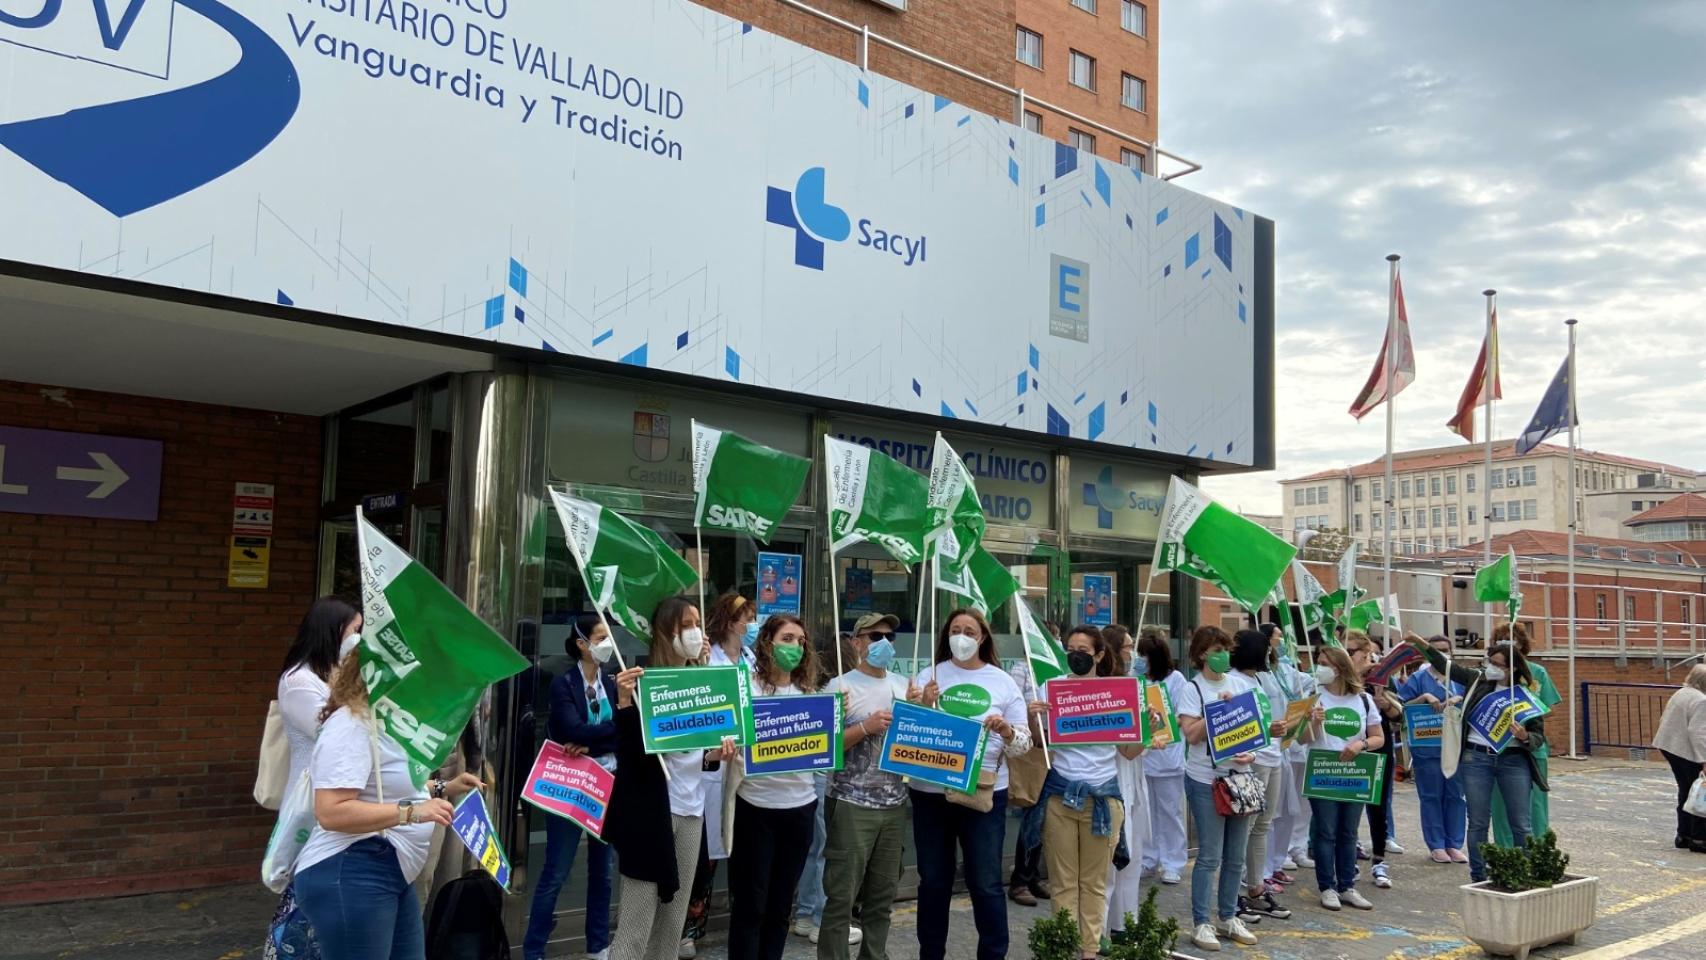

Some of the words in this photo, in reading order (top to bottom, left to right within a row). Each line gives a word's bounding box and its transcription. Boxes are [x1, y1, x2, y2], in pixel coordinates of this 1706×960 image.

[465, 22, 504, 64] DE
[512, 38, 684, 120] VALLADOLID
[287, 12, 505, 109] Vanguardia
[519, 95, 538, 124] y
[551, 95, 683, 161] Tradición
[858, 219, 926, 266] Sacyl
[1059, 263, 1081, 312] E
[628, 465, 687, 486] Castilla
[963, 448, 1048, 485] CLÍNICO
[707, 504, 774, 537] SATSE
[650, 685, 711, 703] Enfermeras
[738, 669, 749, 708] SATSE
[1057, 691, 1112, 705] Enfermeras
[652, 702, 677, 717] para
[679, 700, 693, 709] un
[695, 694, 726, 708] futuro
[1058, 704, 1081, 716] para
[1082, 702, 1095, 711] un
[1096, 699, 1127, 710] futuro
[1211, 706, 1244, 726] Enfermeras
[658, 713, 725, 733] saludable
[754, 711, 810, 729] Enfermeras
[898, 721, 953, 737] Enfermeras
[1061, 715, 1126, 731] equitativo
[1214, 722, 1229, 735] para
[1229, 718, 1238, 727] un
[1237, 710, 1253, 723] futuro
[755, 729, 778, 742] para
[779, 725, 792, 734] un
[794, 720, 823, 733] futuro
[896, 733, 919, 743] para
[920, 736, 933, 745] un
[935, 737, 964, 749] futuro
[1218, 725, 1256, 747] innovador
[1415, 727, 1442, 737] sosten
[757, 738, 821, 757] innovador
[894, 747, 958, 767] sostenible
[546, 760, 598, 784] Enfermeras
[1314, 777, 1362, 788] saludable
[542, 770, 565, 781] para
[567, 776, 580, 785] un
[581, 779, 605, 798] futuro
[539, 783, 598, 812] equitativo
